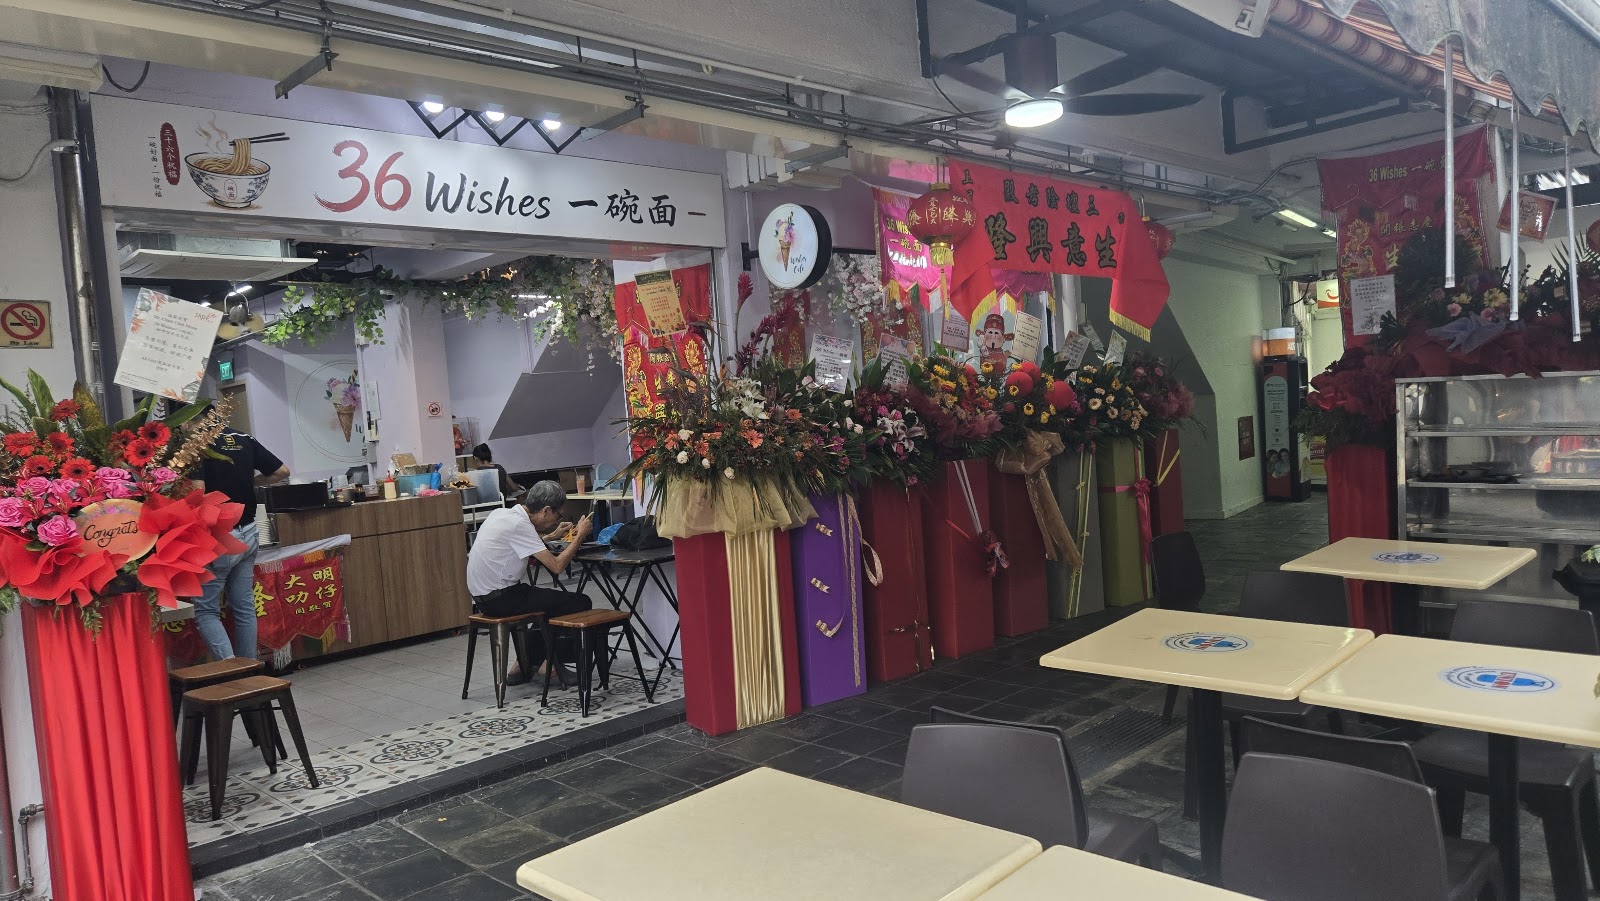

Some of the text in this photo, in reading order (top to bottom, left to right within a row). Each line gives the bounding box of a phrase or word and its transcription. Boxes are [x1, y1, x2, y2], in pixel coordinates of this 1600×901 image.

[164, 129, 178, 179] 三十六个祝福
[313, 139, 676, 227] 36 Wishes 一碗面
[1368, 169, 1378, 182] 36
[1379, 166, 1408, 180] Wishes
[895, 219, 913, 236] Wis
[889, 236, 923, 252] 一碗面
[84, 520, 139, 548] Congrats
